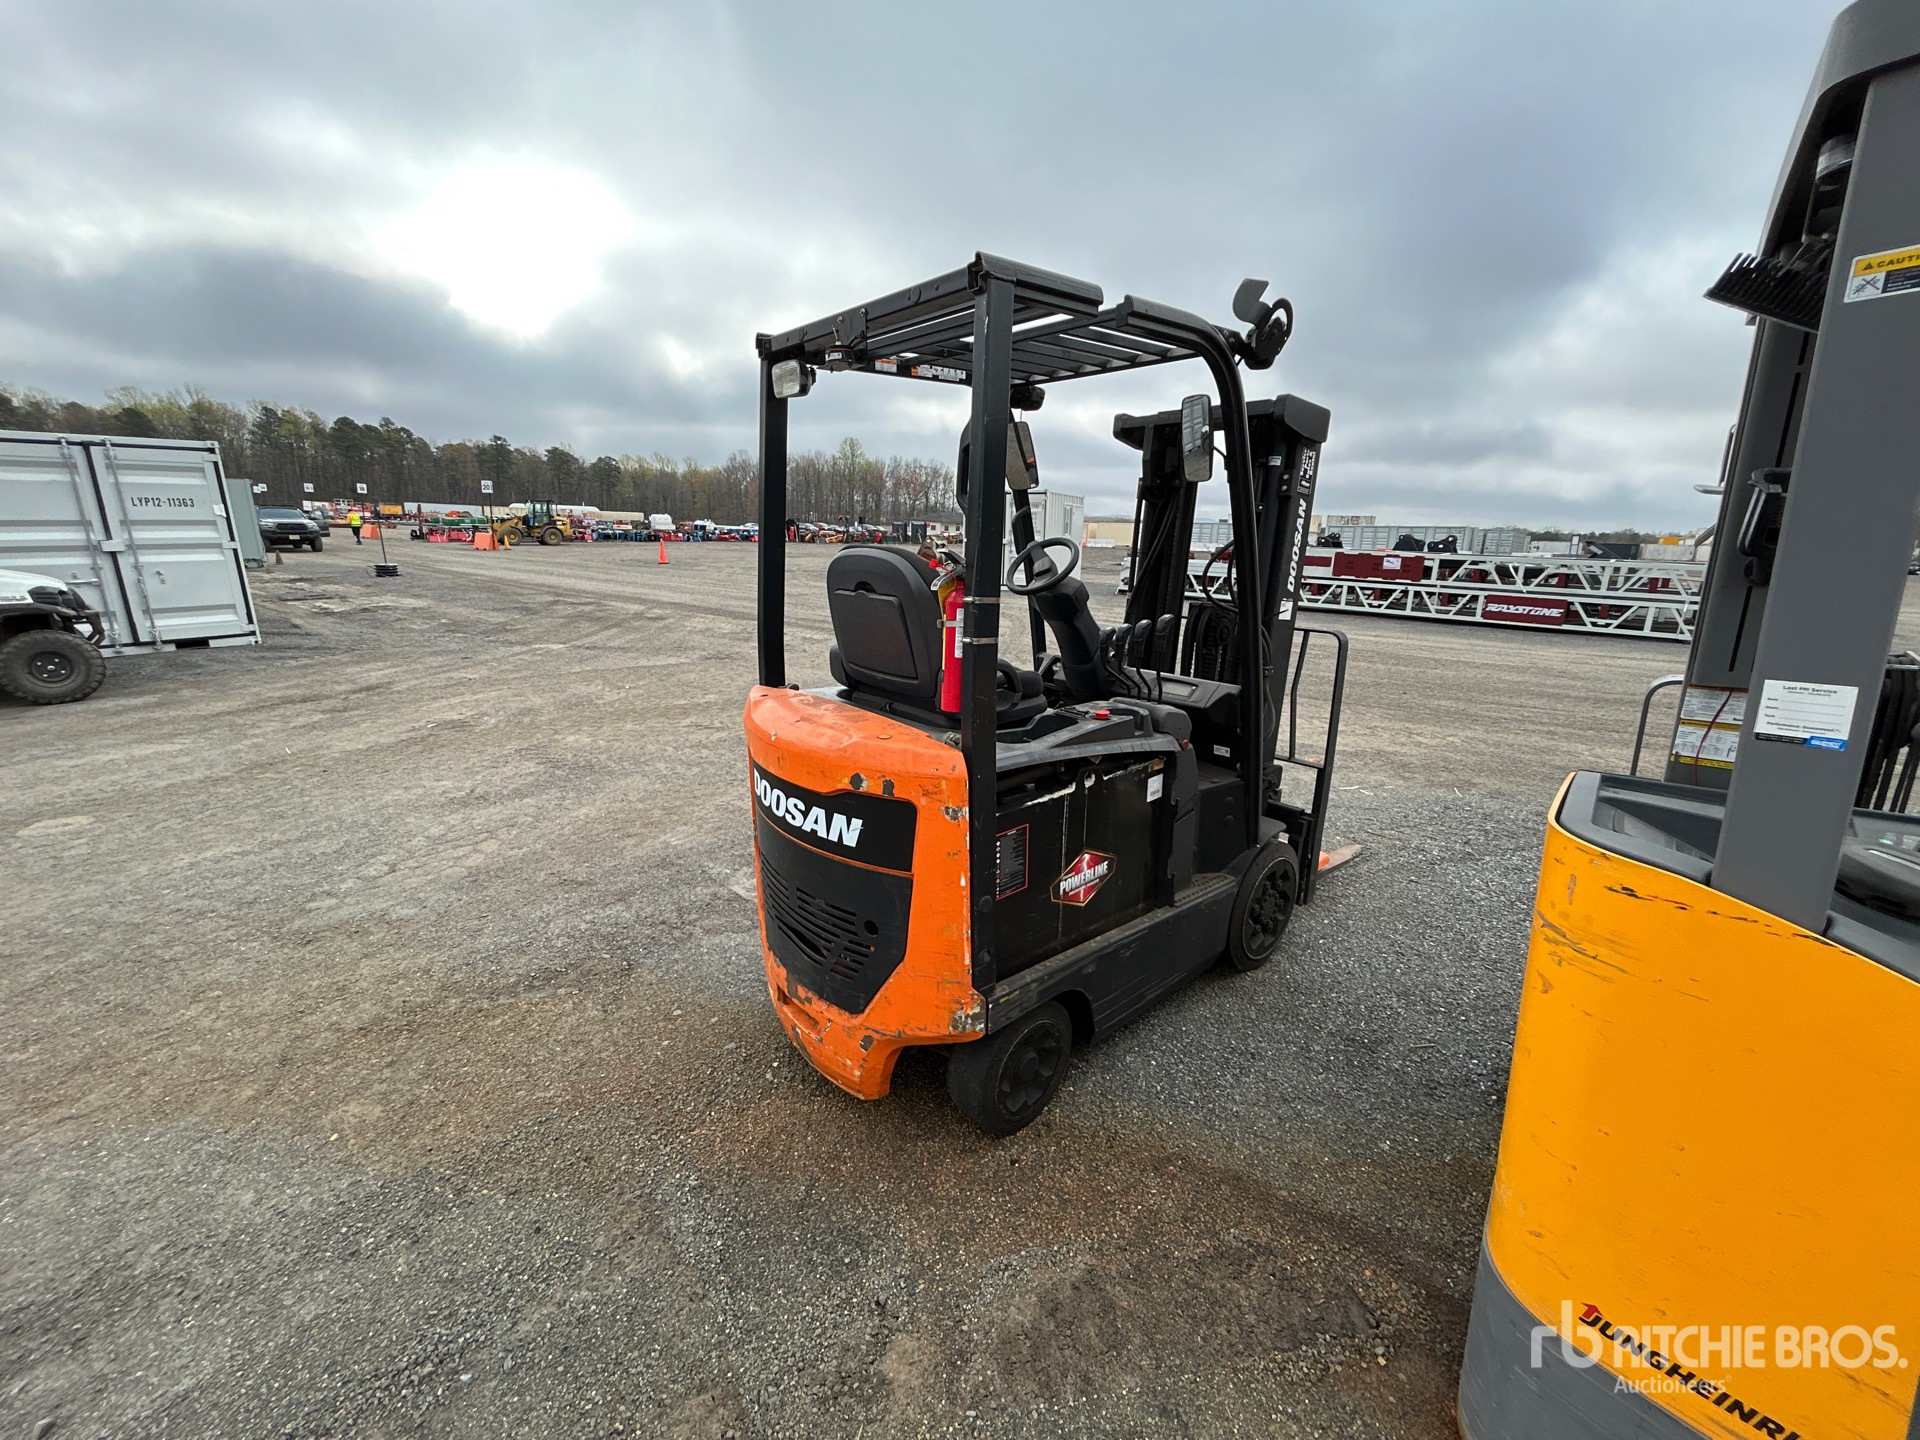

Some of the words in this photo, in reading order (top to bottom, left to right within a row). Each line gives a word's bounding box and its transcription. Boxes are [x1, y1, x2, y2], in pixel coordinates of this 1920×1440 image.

[131, 496, 195, 508] LYP12-11363
[1287, 498, 1307, 593] DOOSAN
[754, 767, 863, 848] DOOSAN
[1060, 860, 1109, 896] POWERLINE
